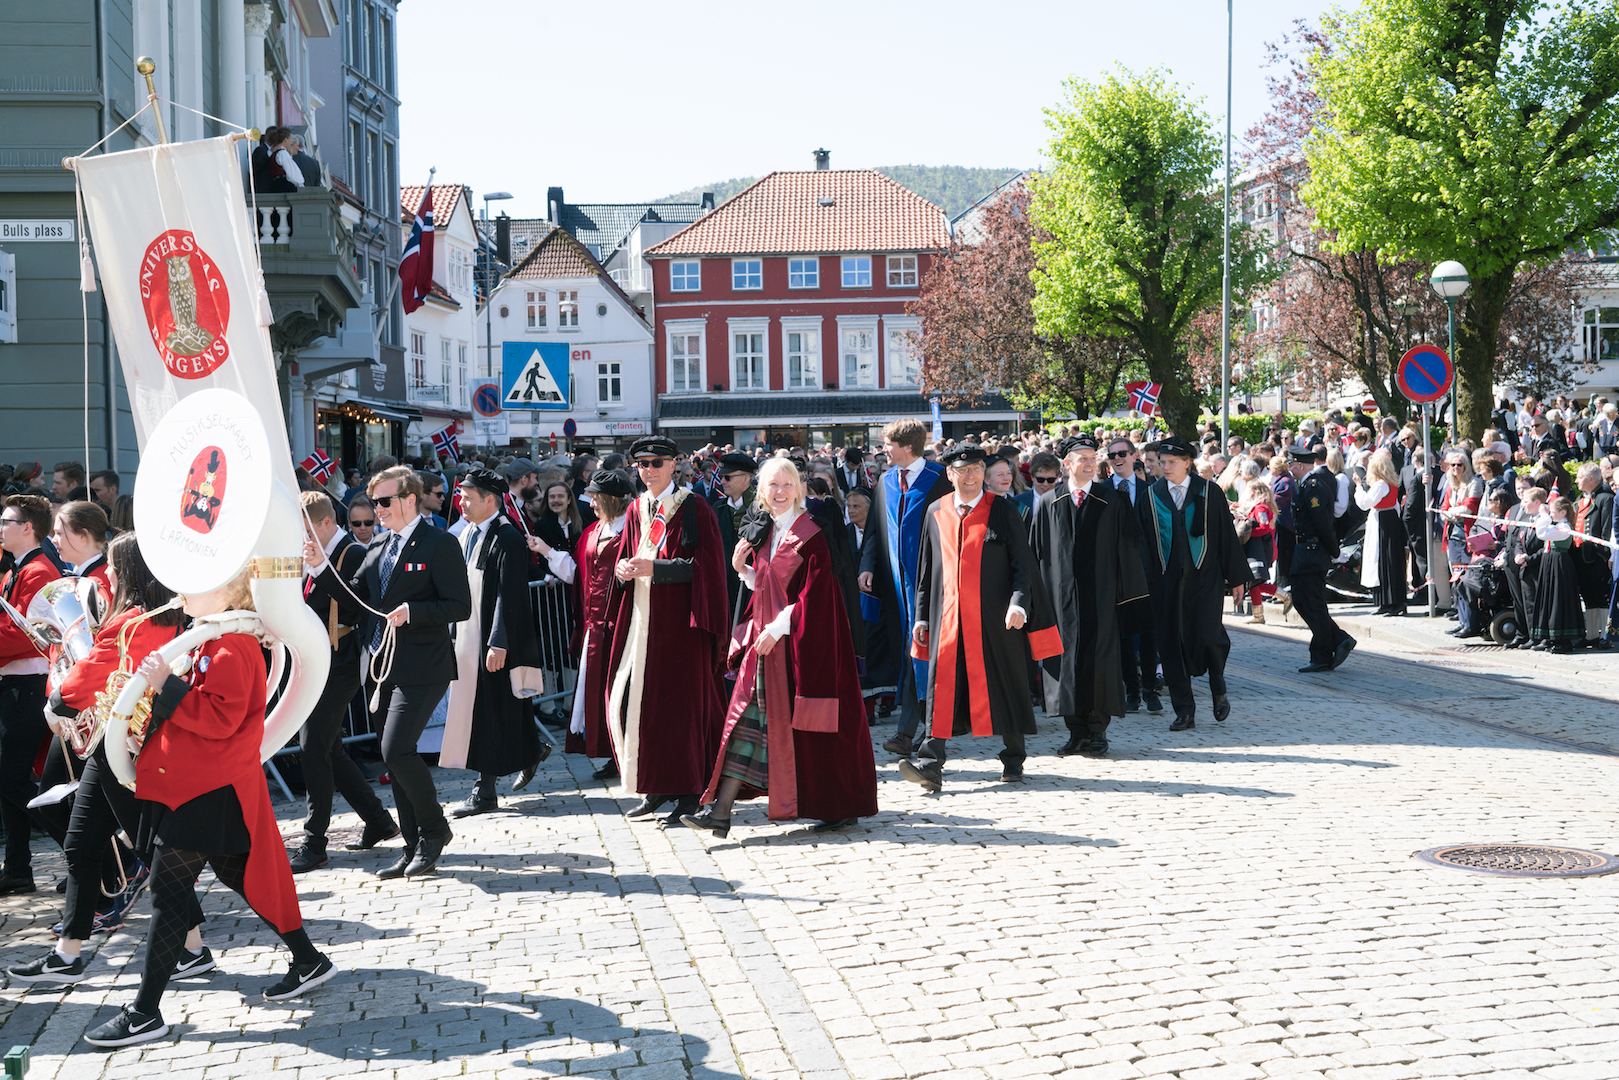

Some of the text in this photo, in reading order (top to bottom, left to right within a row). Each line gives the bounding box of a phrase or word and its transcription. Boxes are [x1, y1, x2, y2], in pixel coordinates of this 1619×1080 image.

[3, 224, 63, 238] Bulls plass
[571, 349, 591, 361] en
[605, 421, 643, 435] elefanten
[160, 524, 218, 558] LARMONIEN
